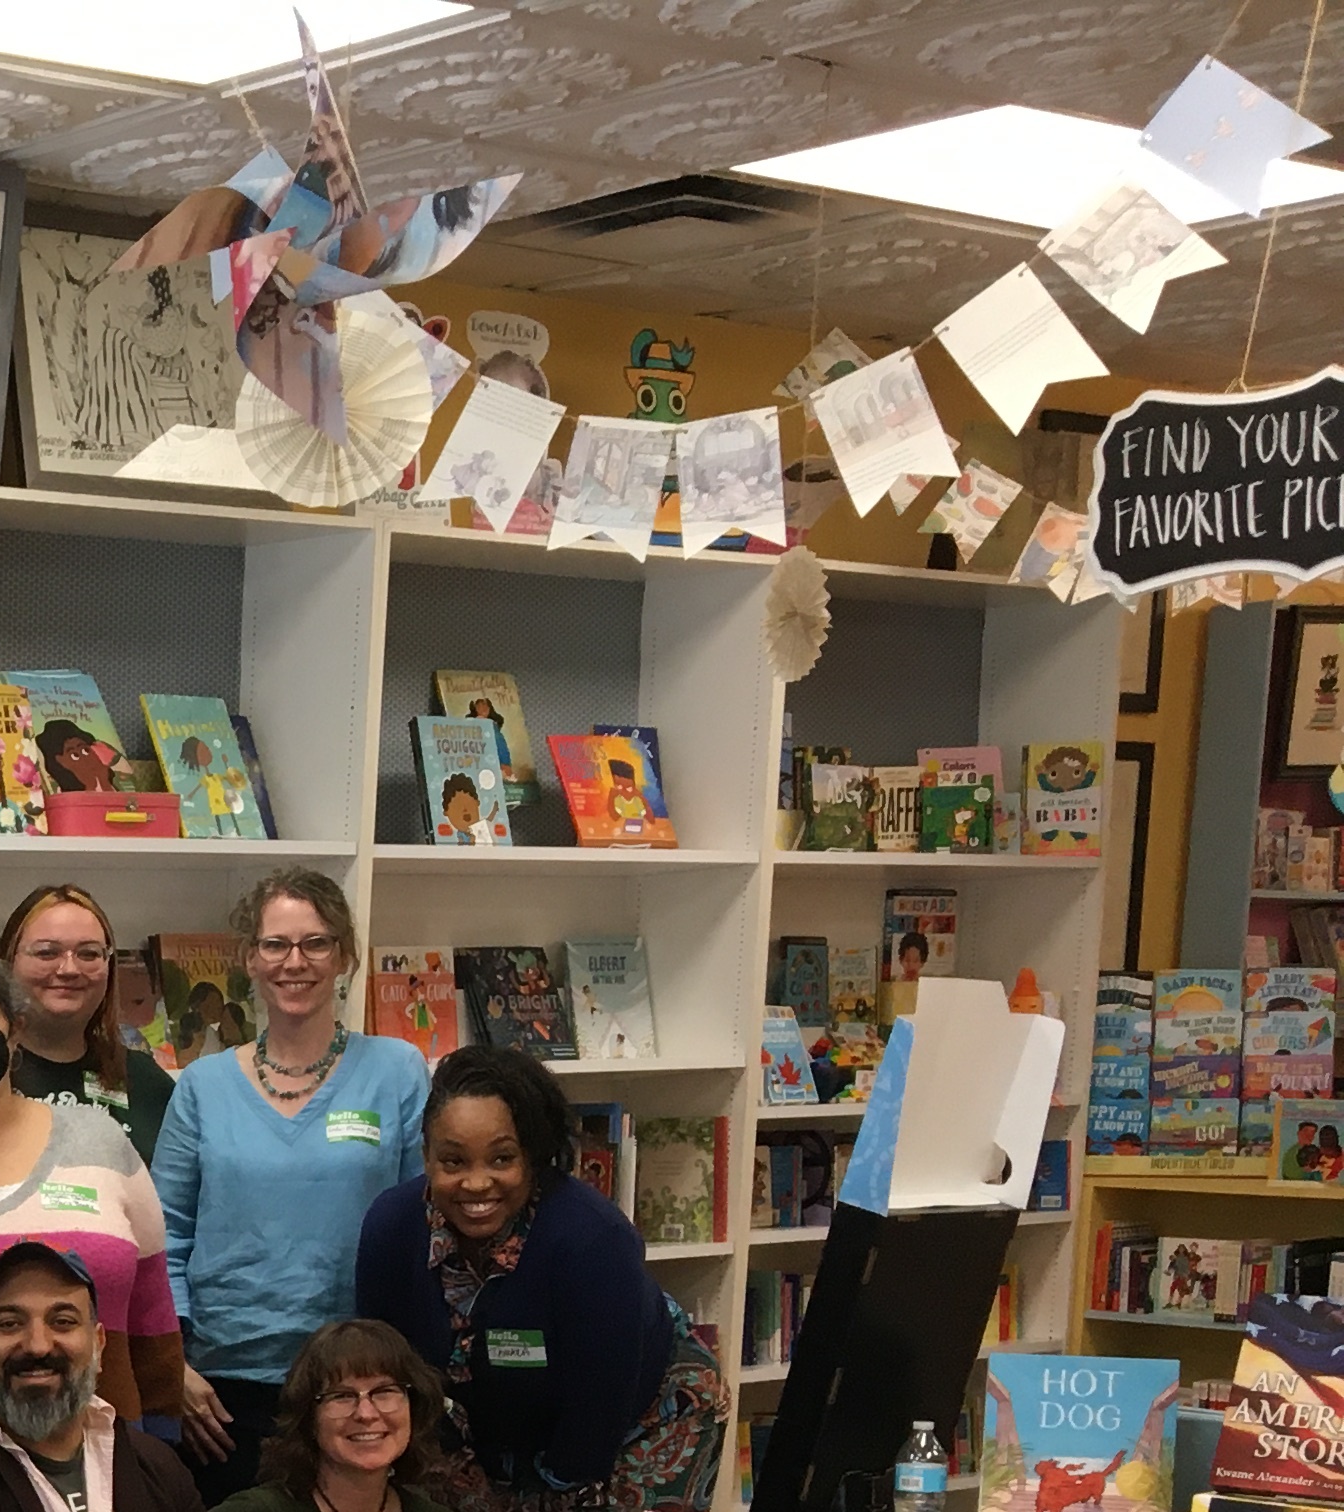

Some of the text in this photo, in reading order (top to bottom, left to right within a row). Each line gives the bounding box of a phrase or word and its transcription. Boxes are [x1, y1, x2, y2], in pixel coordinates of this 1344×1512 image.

[1121, 404, 1340, 479] FIND YOUR
[1113, 479, 1267, 557] FAVORITE
[588, 955, 627, 972] ELBERT
[1195, 1125, 1227, 1143] GO!
[1041, 1368, 1124, 1399] HOT
[1250, 1371, 1301, 1395] AN
[1038, 1402, 1123, 1432] DOG
[1214, 1466, 1315, 1488] Kwame Alexander
